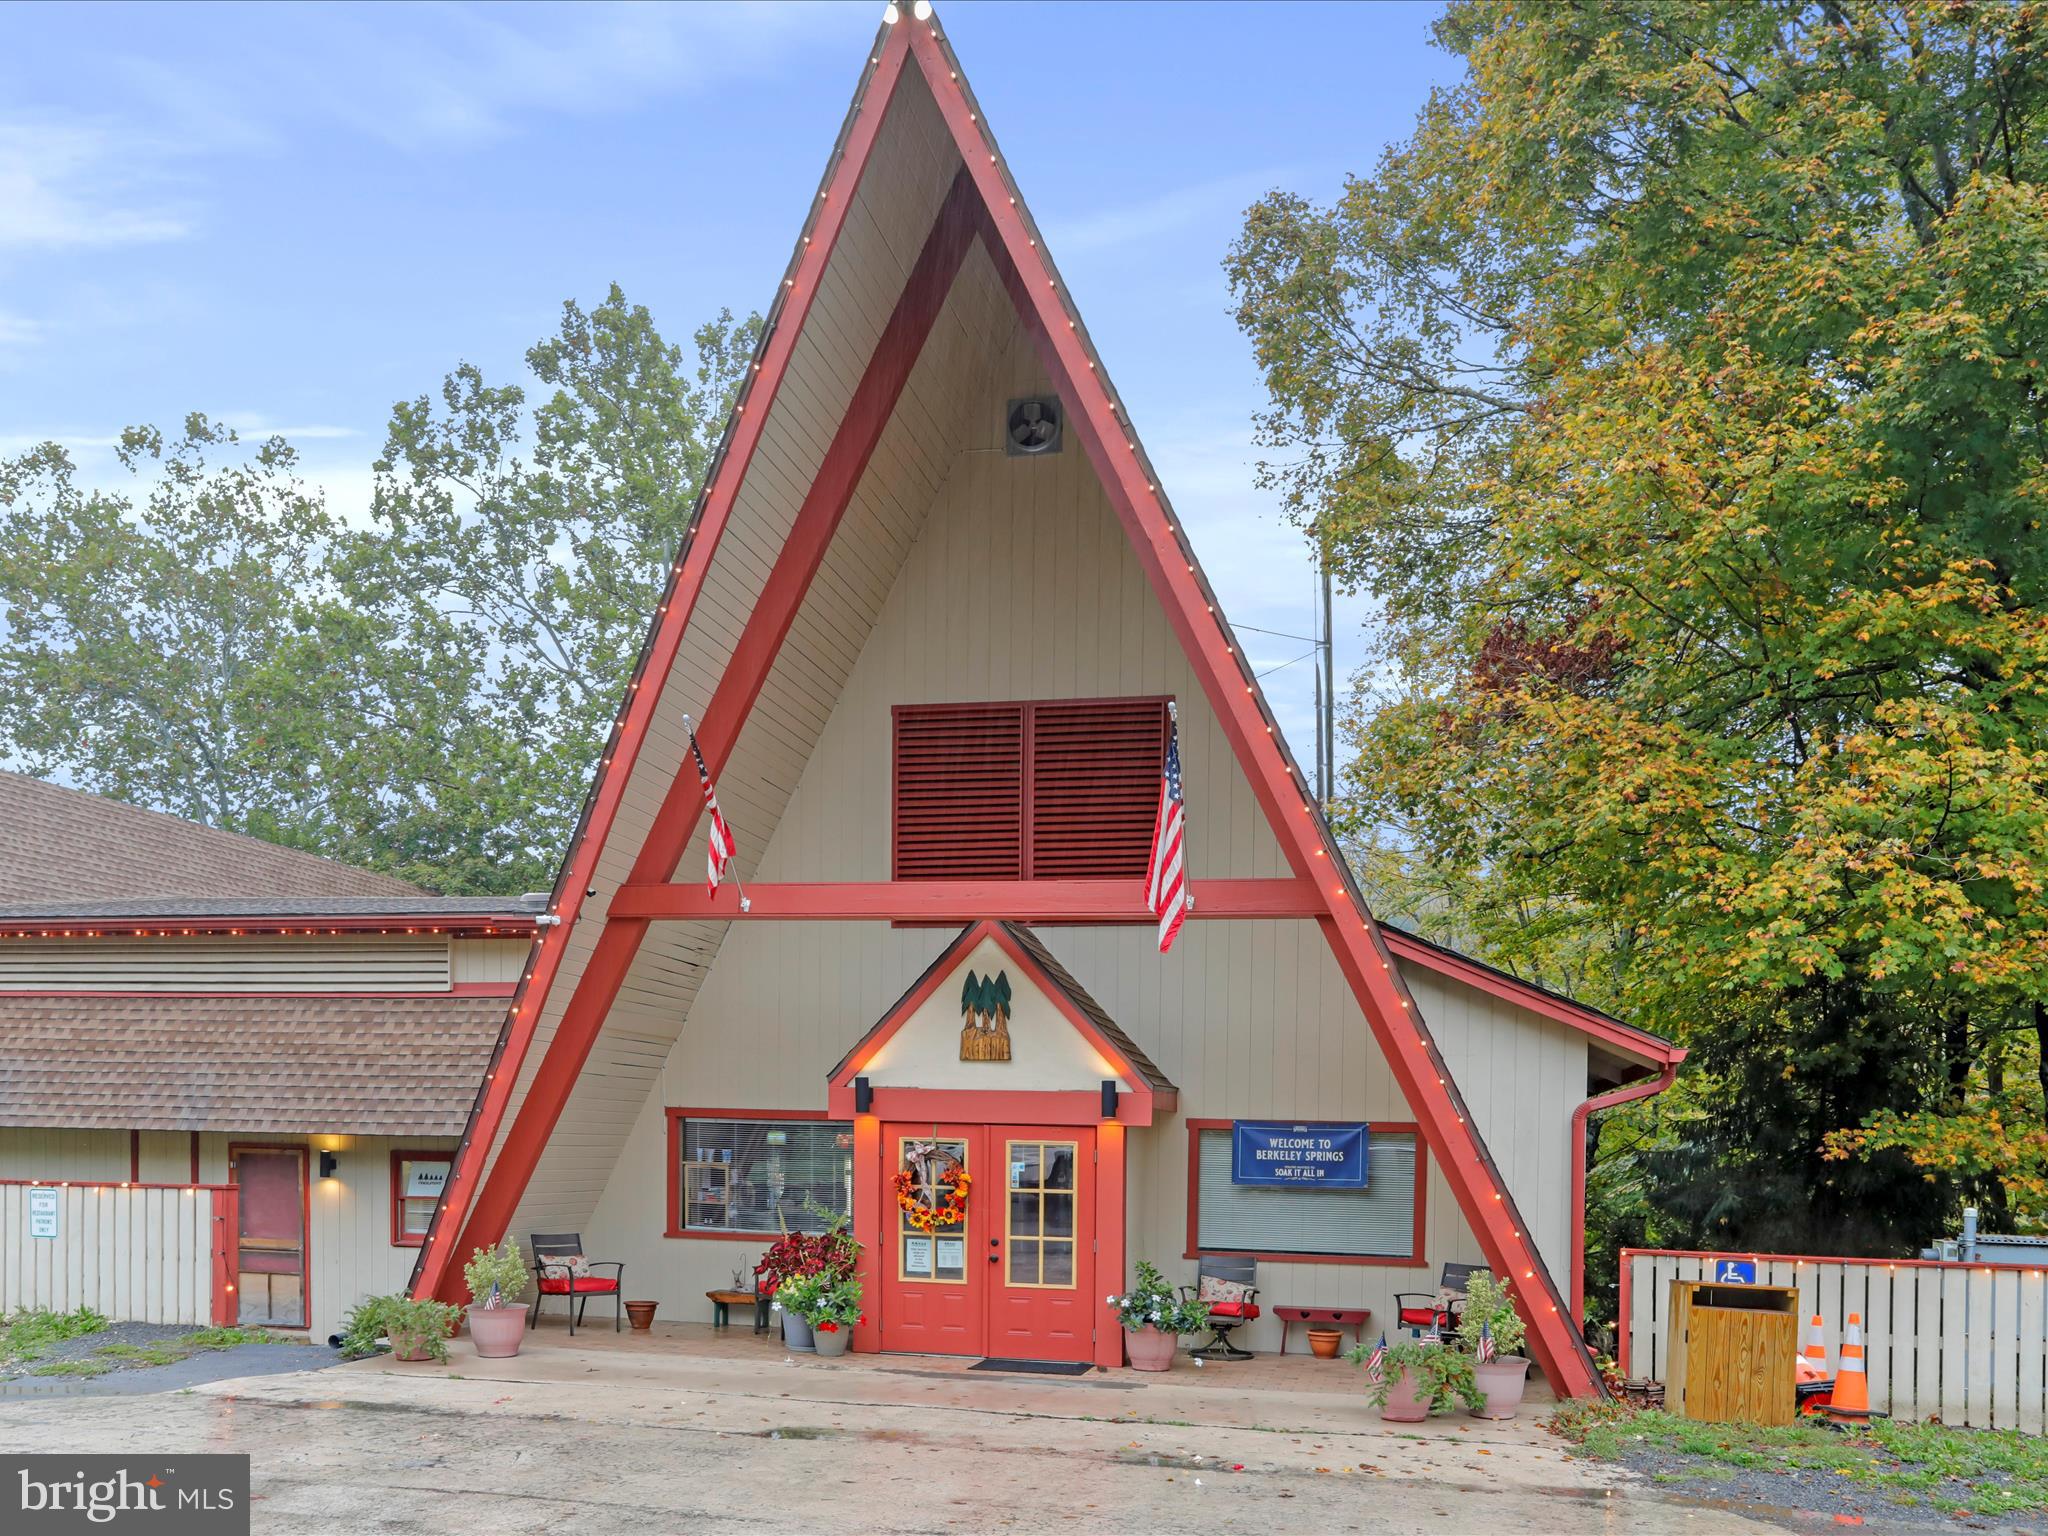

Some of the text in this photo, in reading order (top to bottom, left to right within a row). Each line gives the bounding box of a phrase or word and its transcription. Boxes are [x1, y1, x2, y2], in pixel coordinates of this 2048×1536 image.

[1270, 1138, 1331, 1149] WELCOME TO
[1256, 1150, 1344, 1161] BERKELEY SPRINGS
[1274, 1168, 1324, 1177] SOAK IT ALL IN
